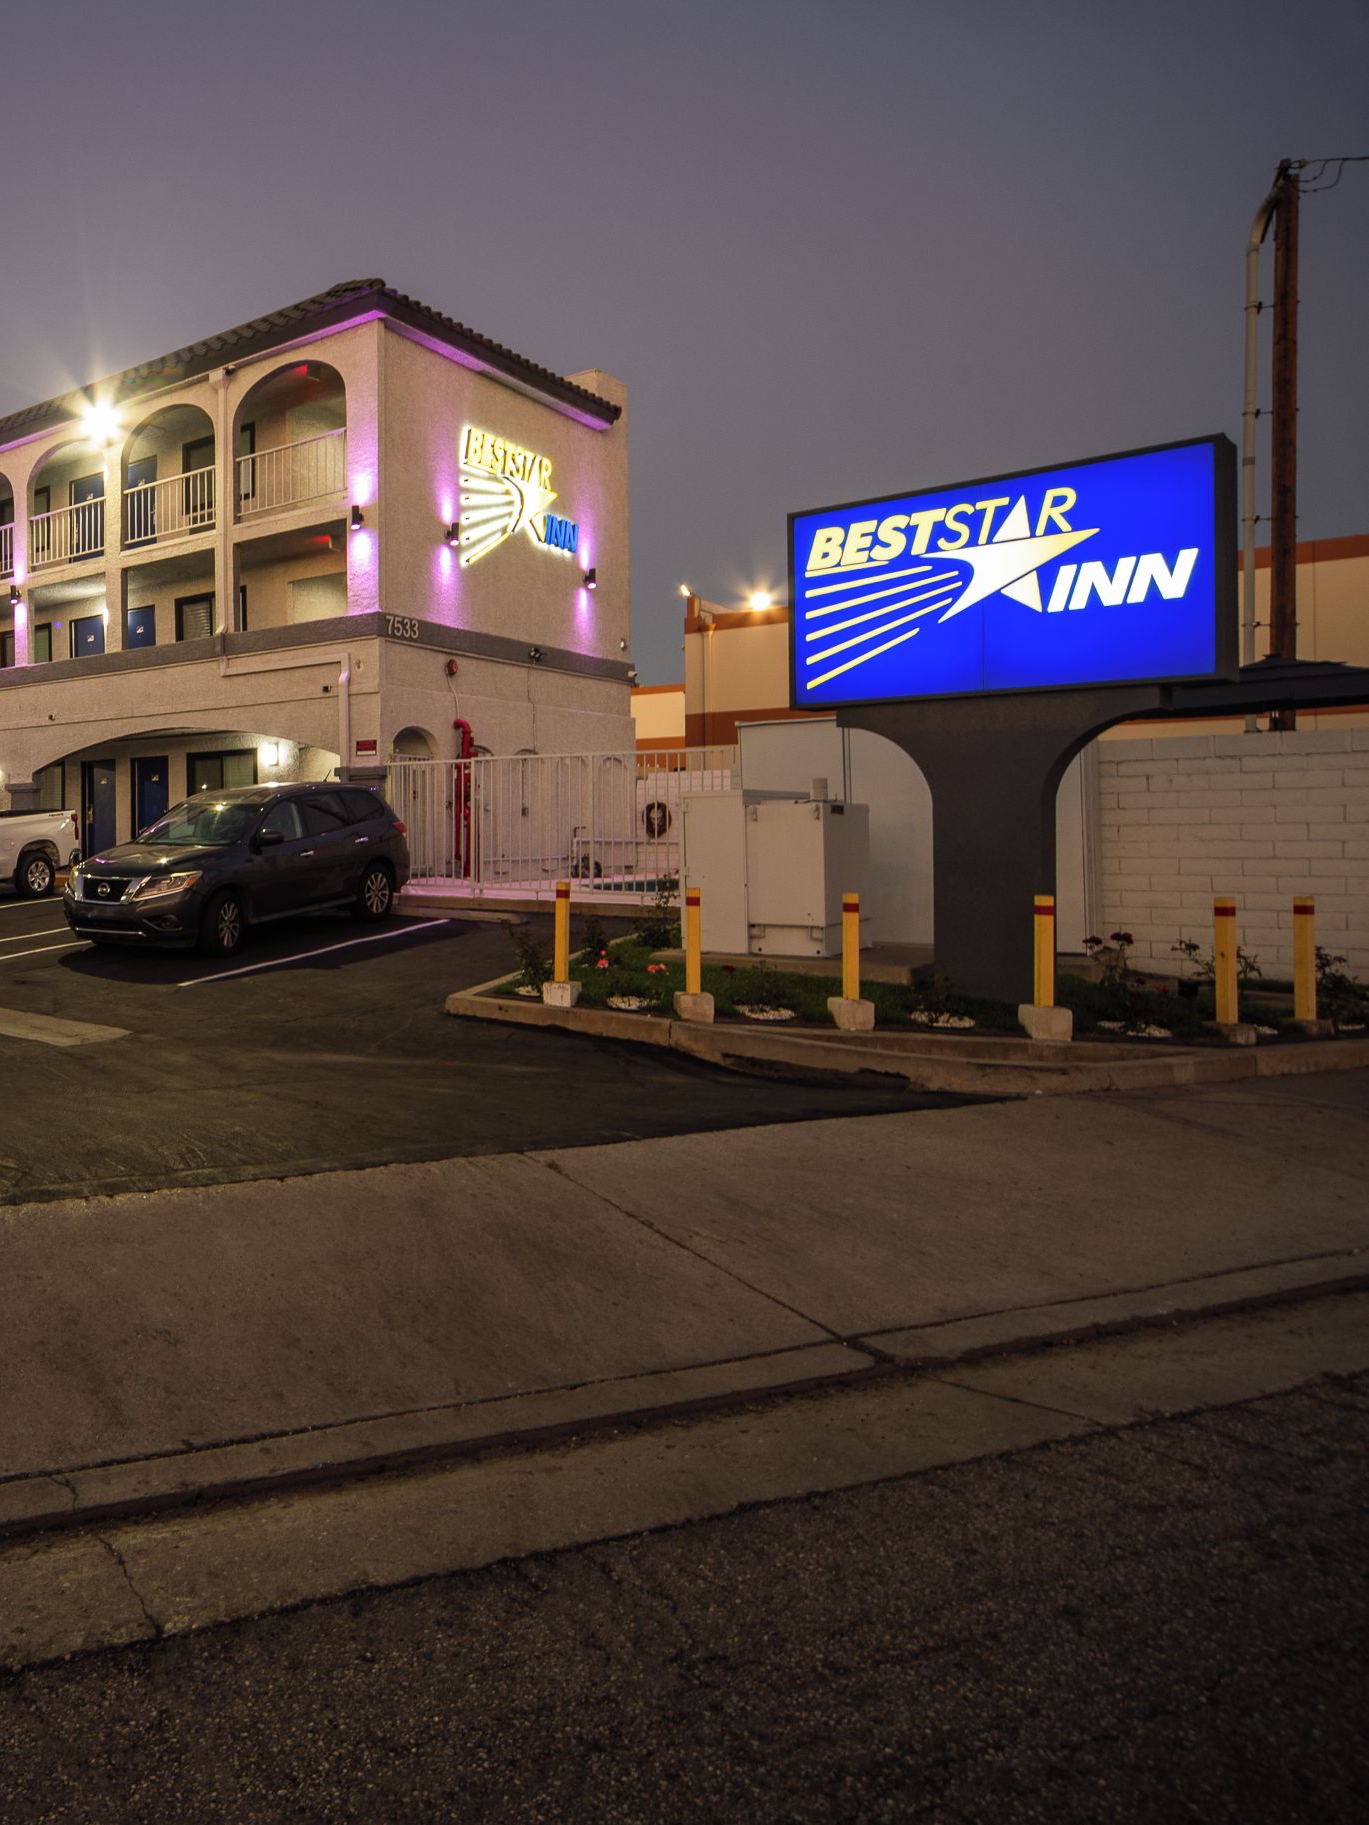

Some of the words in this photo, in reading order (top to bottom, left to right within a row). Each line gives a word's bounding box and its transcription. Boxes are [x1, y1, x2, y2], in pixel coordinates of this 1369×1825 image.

[467, 427, 553, 490] BESTSTAR
[544, 513, 579, 553] INN
[806, 486, 1077, 571] BESTSTAR
[1047, 547, 1199, 613] INN
[386, 615, 419, 639] 7533
